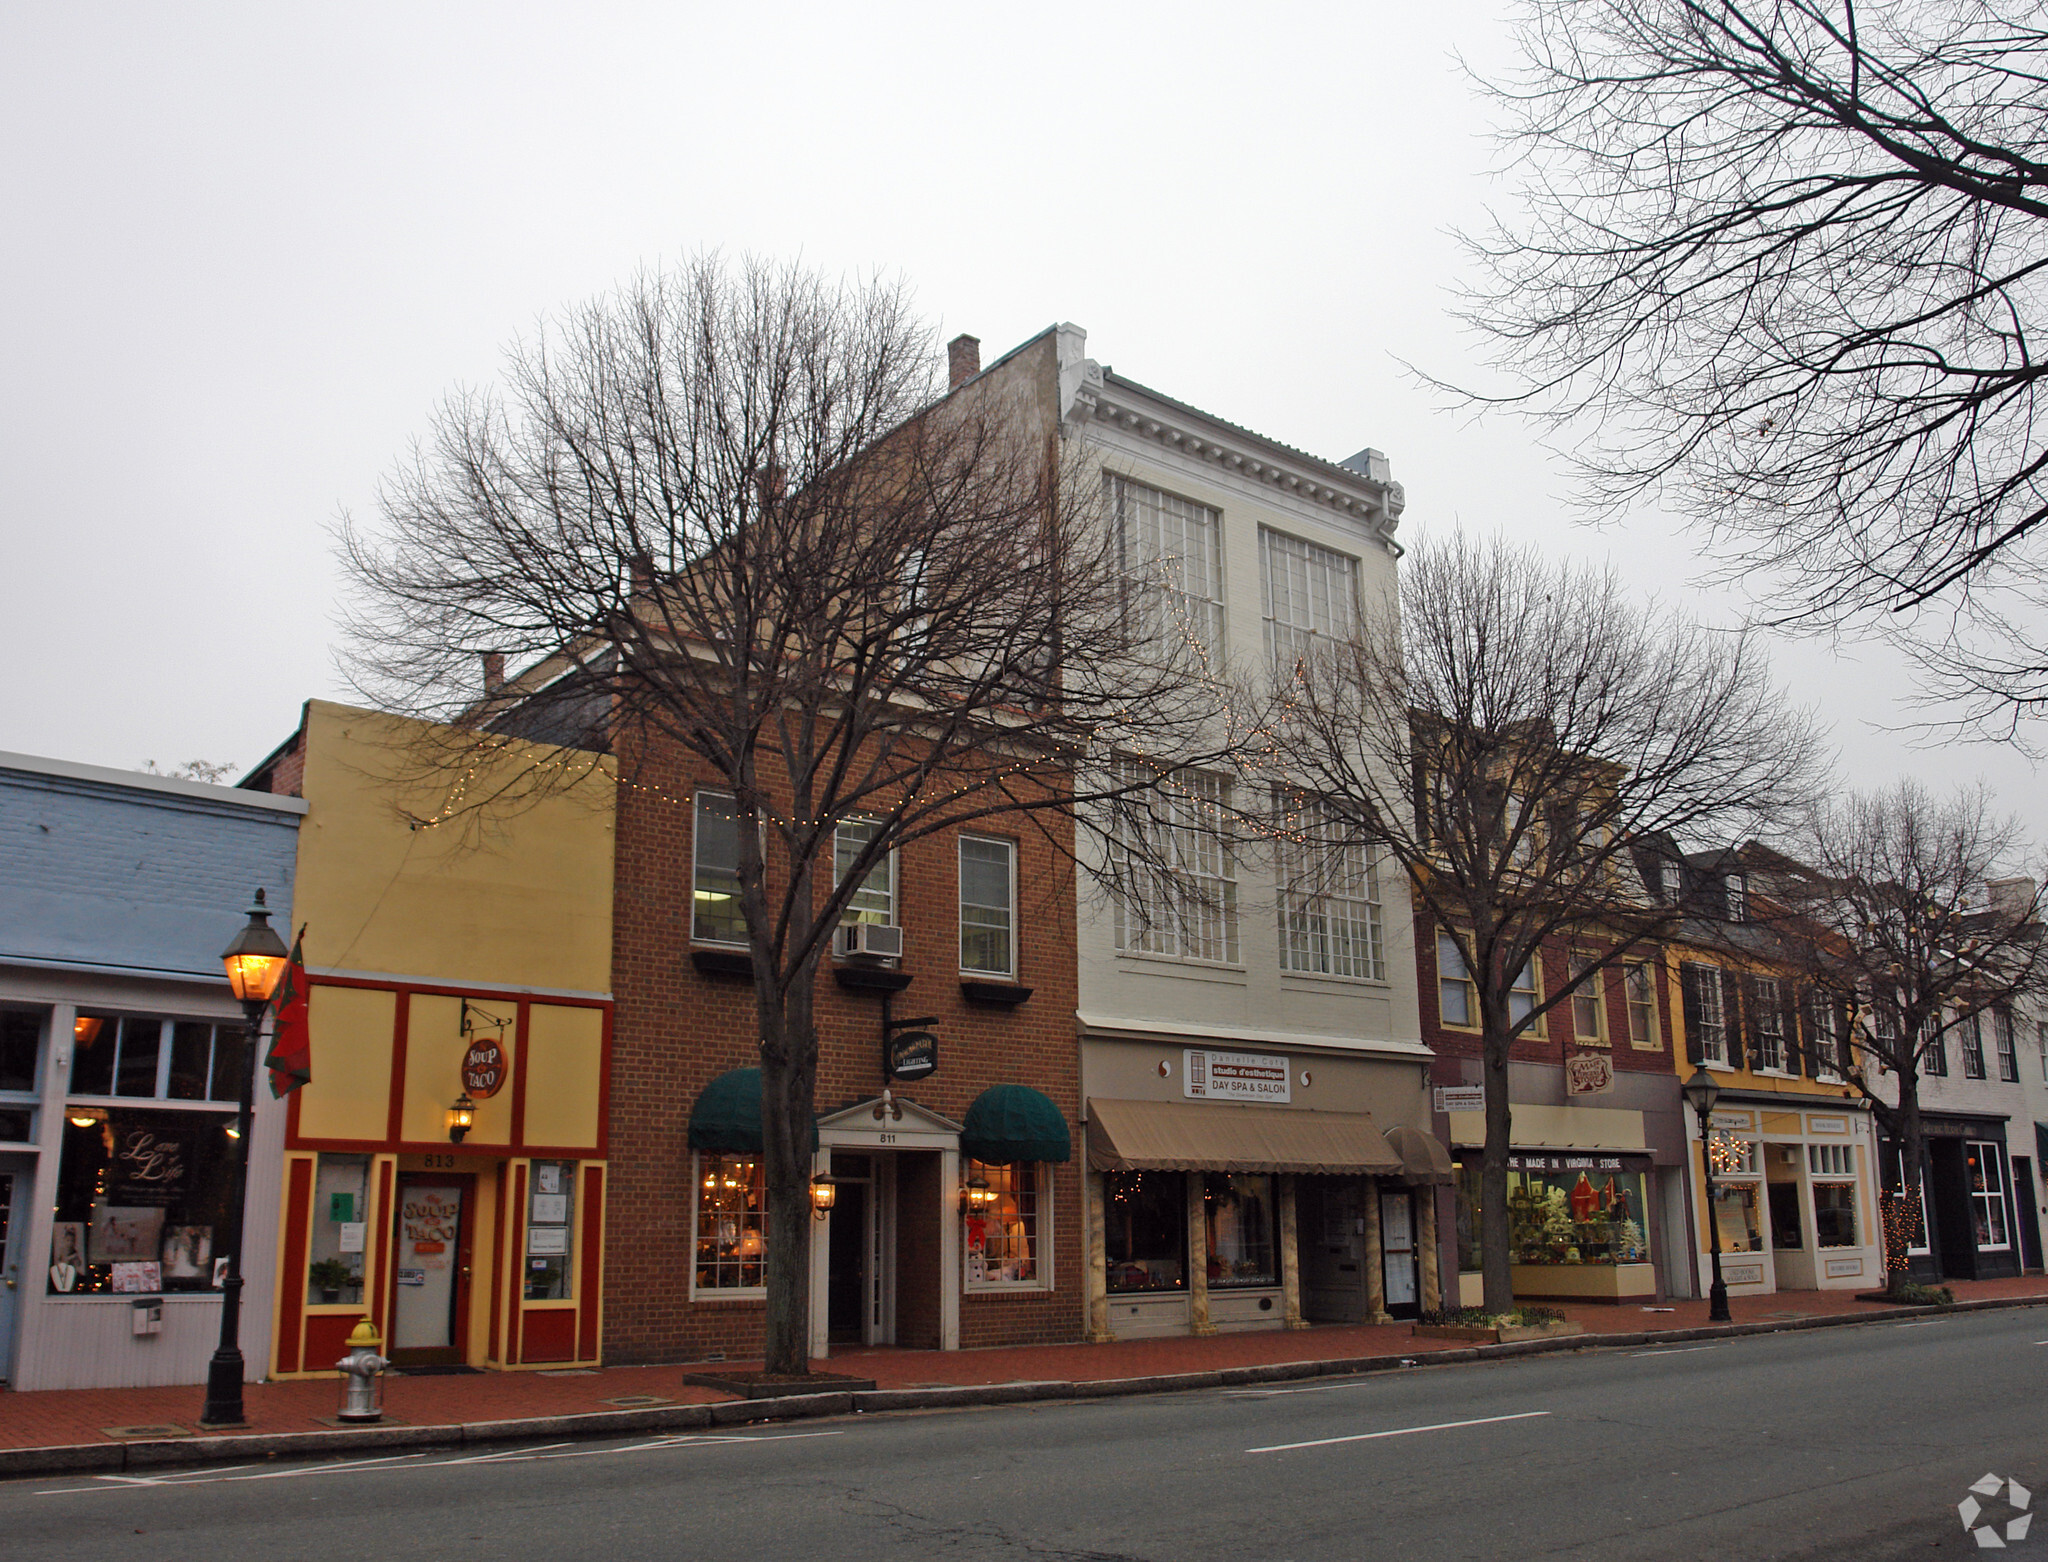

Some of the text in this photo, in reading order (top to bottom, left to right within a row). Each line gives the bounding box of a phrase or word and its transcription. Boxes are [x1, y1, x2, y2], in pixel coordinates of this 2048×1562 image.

[469, 1048, 497, 1067] SOUP
[1213, 1066, 1237, 1076] studio
[468, 1070, 495, 1088] TACO
[1212, 1080, 1286, 1094] DAY SPA & SALON
[880, 1134, 896, 1144] 811
[424, 1154, 454, 1168] 813
[1525, 1158, 1546, 1168] MADE
[1551, 1158, 1560, 1168] IN
[1565, 1157, 1594, 1169] VIRGINIA
[1600, 1158, 1621, 1169] STORE
[404, 1202, 459, 1219] SOUP
[404, 1224, 456, 1243] TACO
